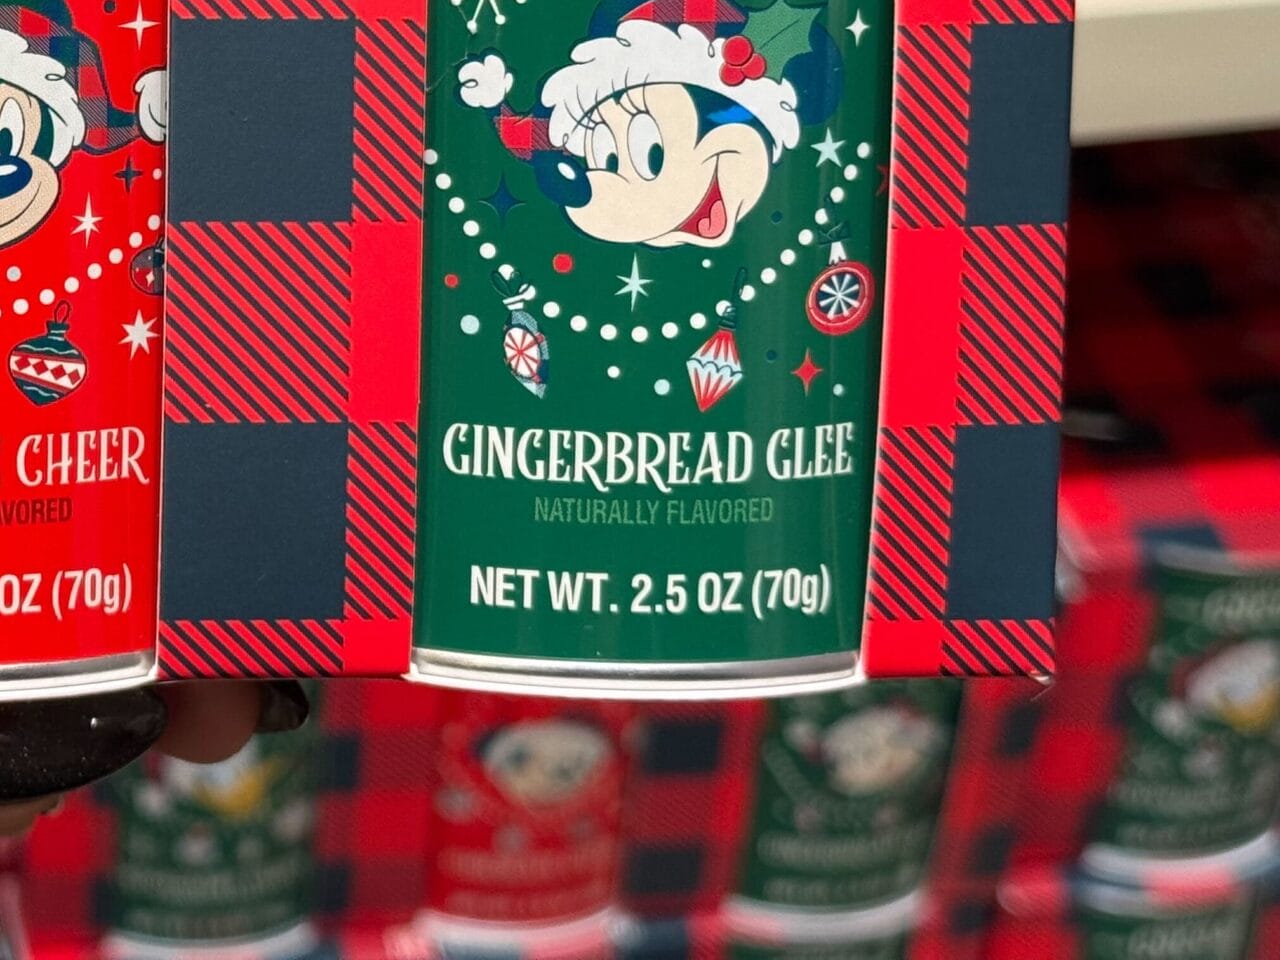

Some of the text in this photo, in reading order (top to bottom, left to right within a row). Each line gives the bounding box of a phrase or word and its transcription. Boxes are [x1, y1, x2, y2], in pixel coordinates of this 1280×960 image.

[17, 426, 149, 487] CHEER
[442, 421, 855, 494] GINGERBREAD GLEE
[534, 496, 774, 525] NATURALLY FLAVORED
[52, 563, 132, 620] (70g)
[470, 564, 831, 620] NET WT. 2.5 OZ (70g)
